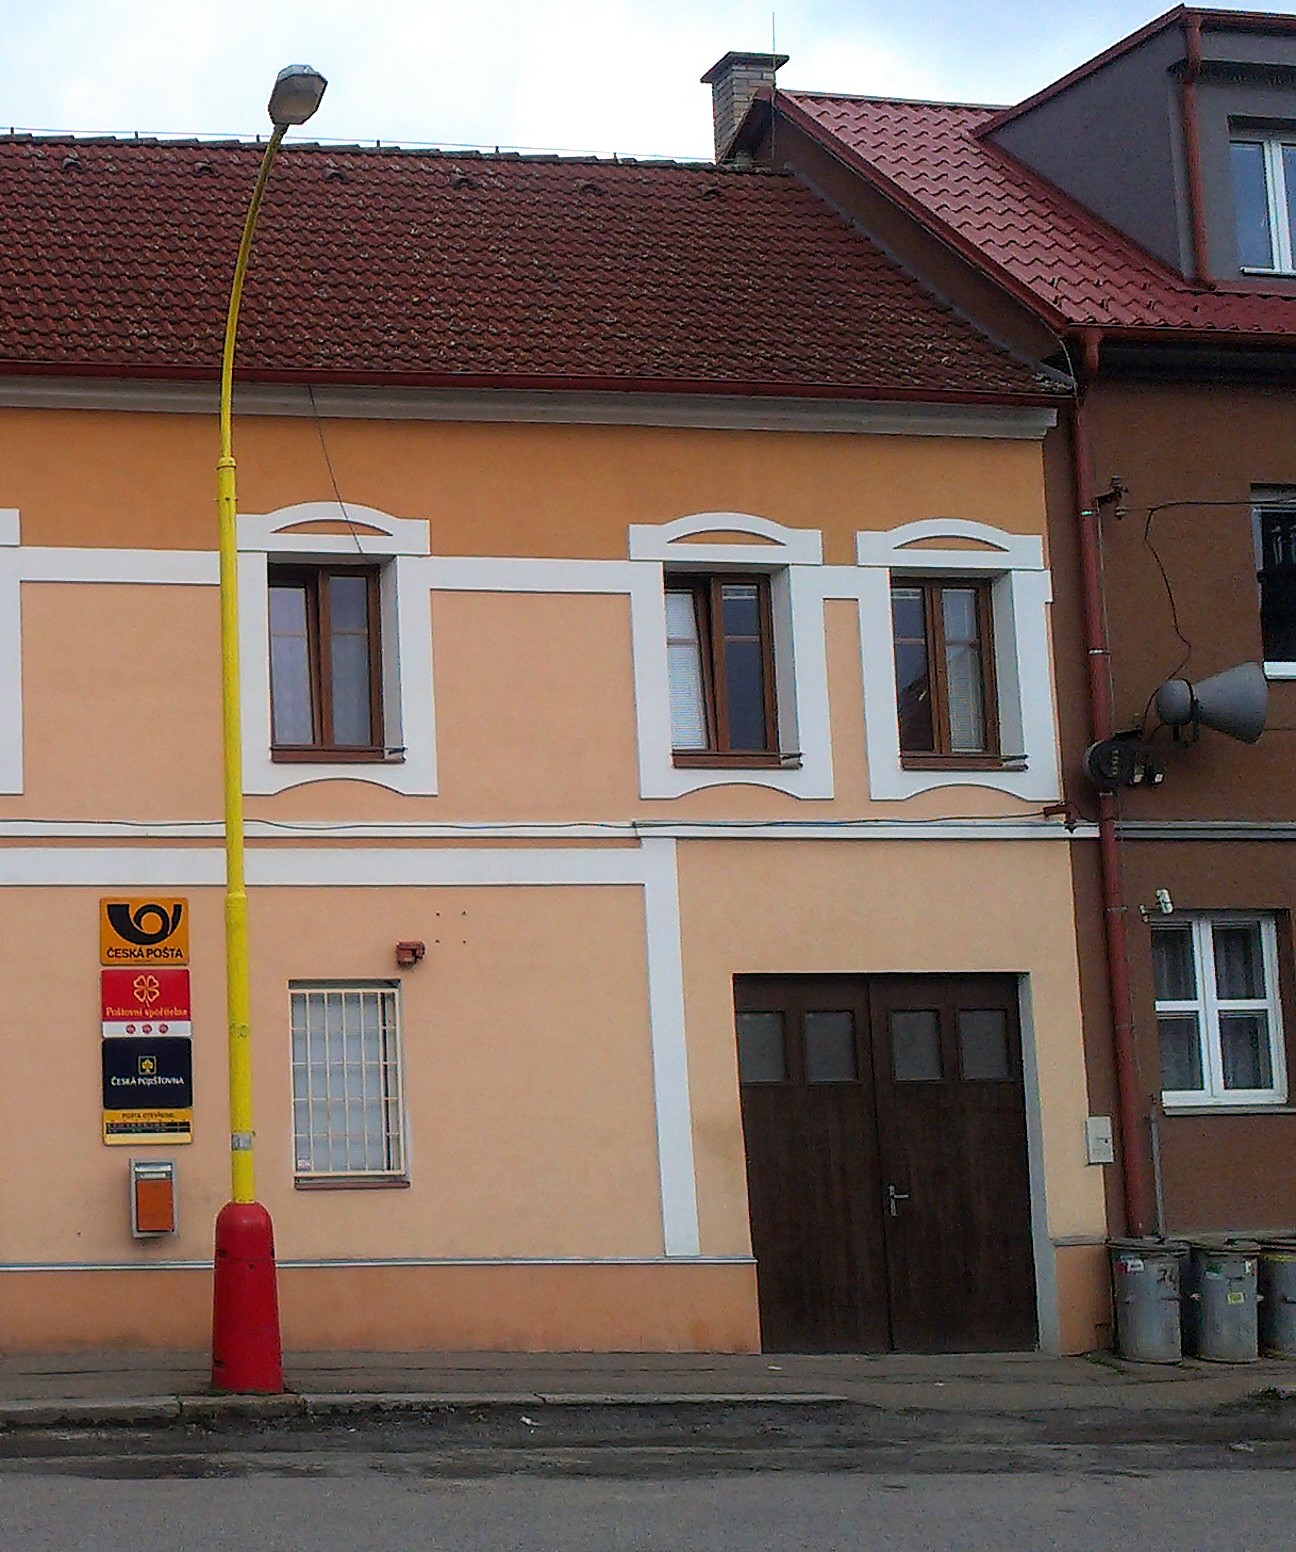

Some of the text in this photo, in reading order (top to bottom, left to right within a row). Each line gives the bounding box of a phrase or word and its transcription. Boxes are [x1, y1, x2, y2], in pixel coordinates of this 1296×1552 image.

[106, 946, 184, 959] ČESKÁ POŠTA
[110, 1076, 136, 1086] ČESKÁ
